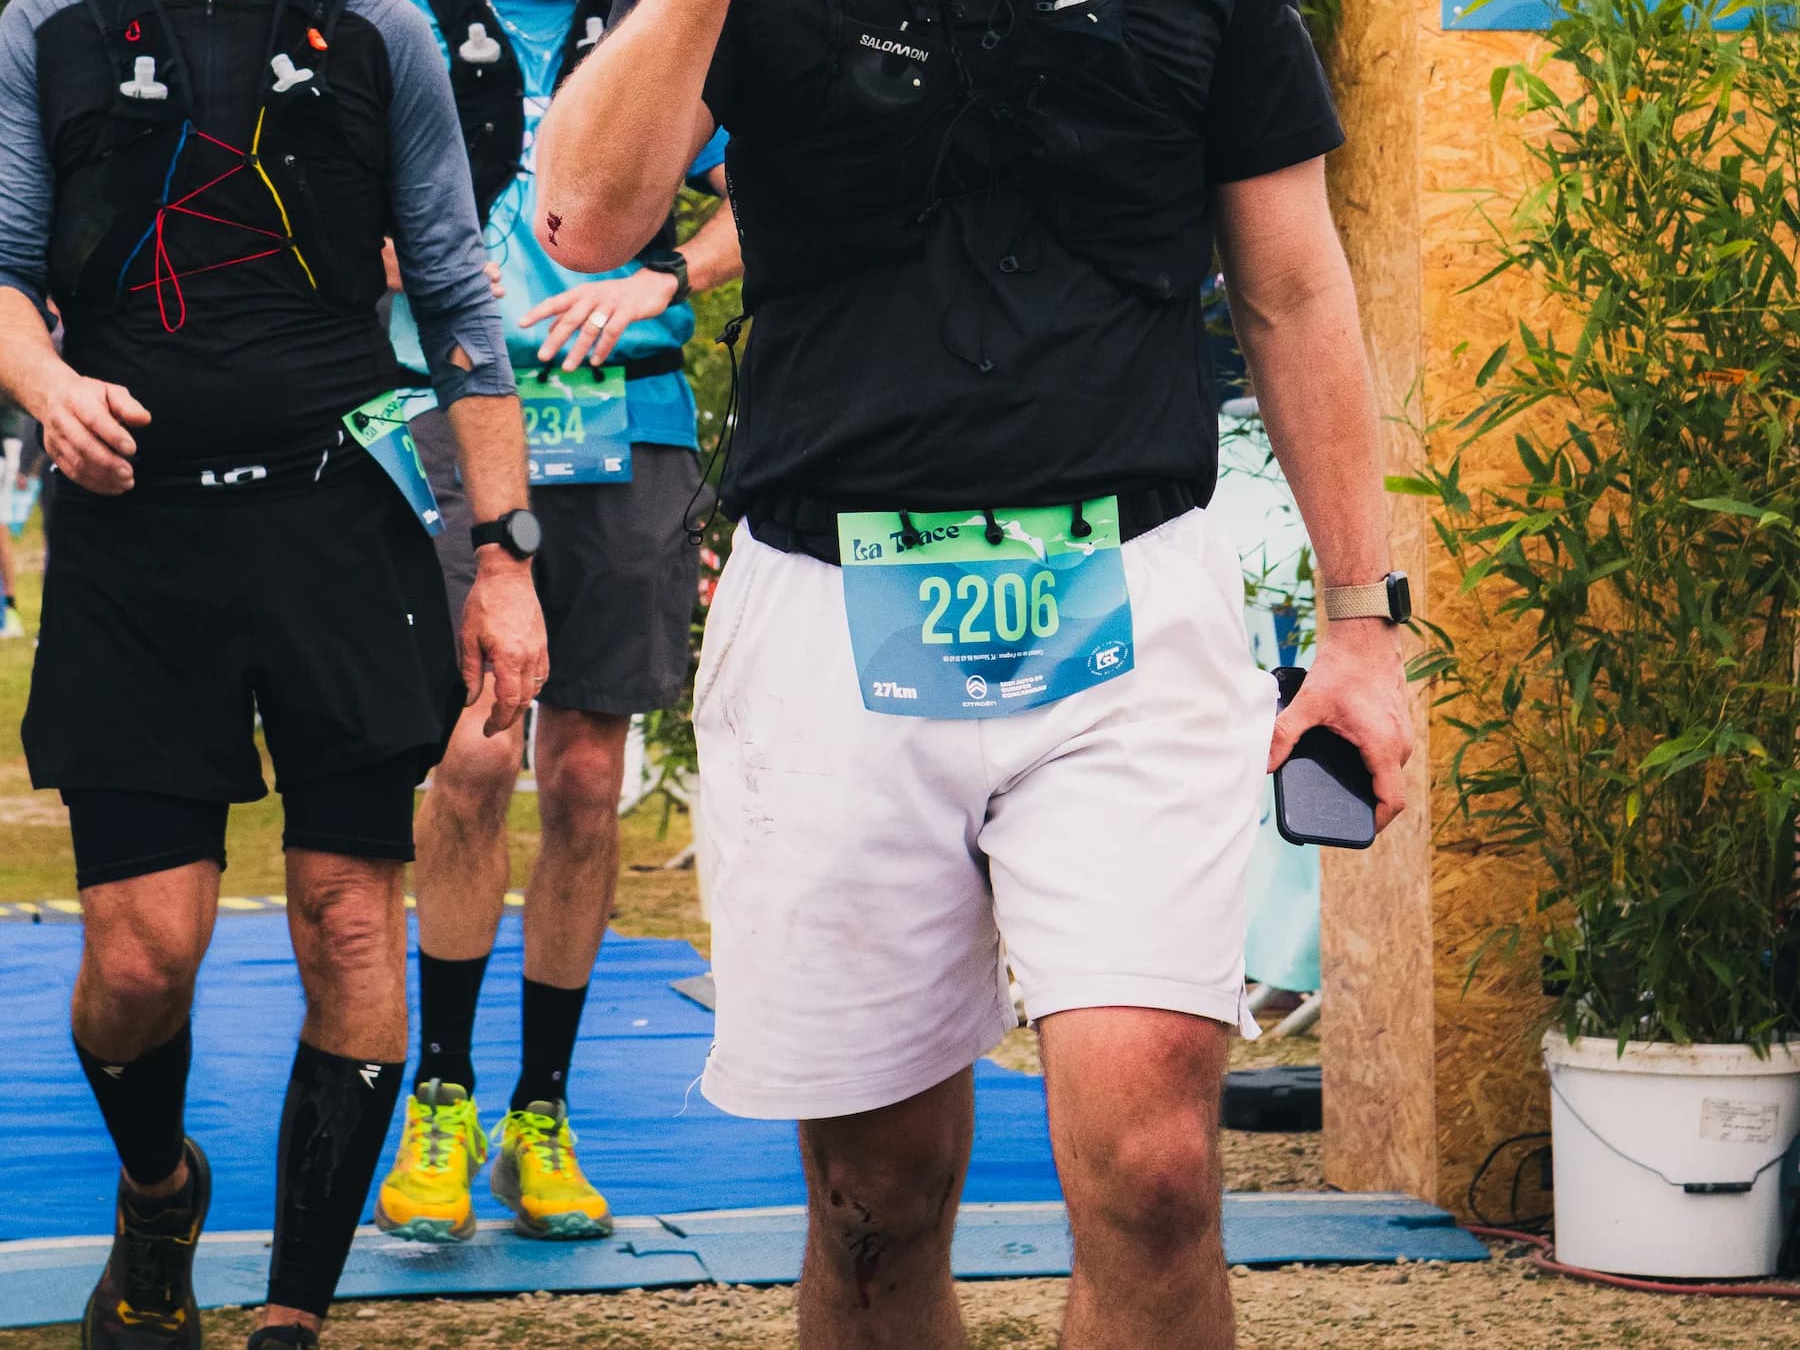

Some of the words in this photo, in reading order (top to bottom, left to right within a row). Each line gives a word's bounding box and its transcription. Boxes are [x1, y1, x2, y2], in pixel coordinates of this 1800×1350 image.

[860, 34, 929, 62] SALOMON
[853, 538, 883, 561] La
[890, 525, 960, 554] Tace
[919, 570, 1061, 645] 2206
[872, 681, 918, 699] 27km
